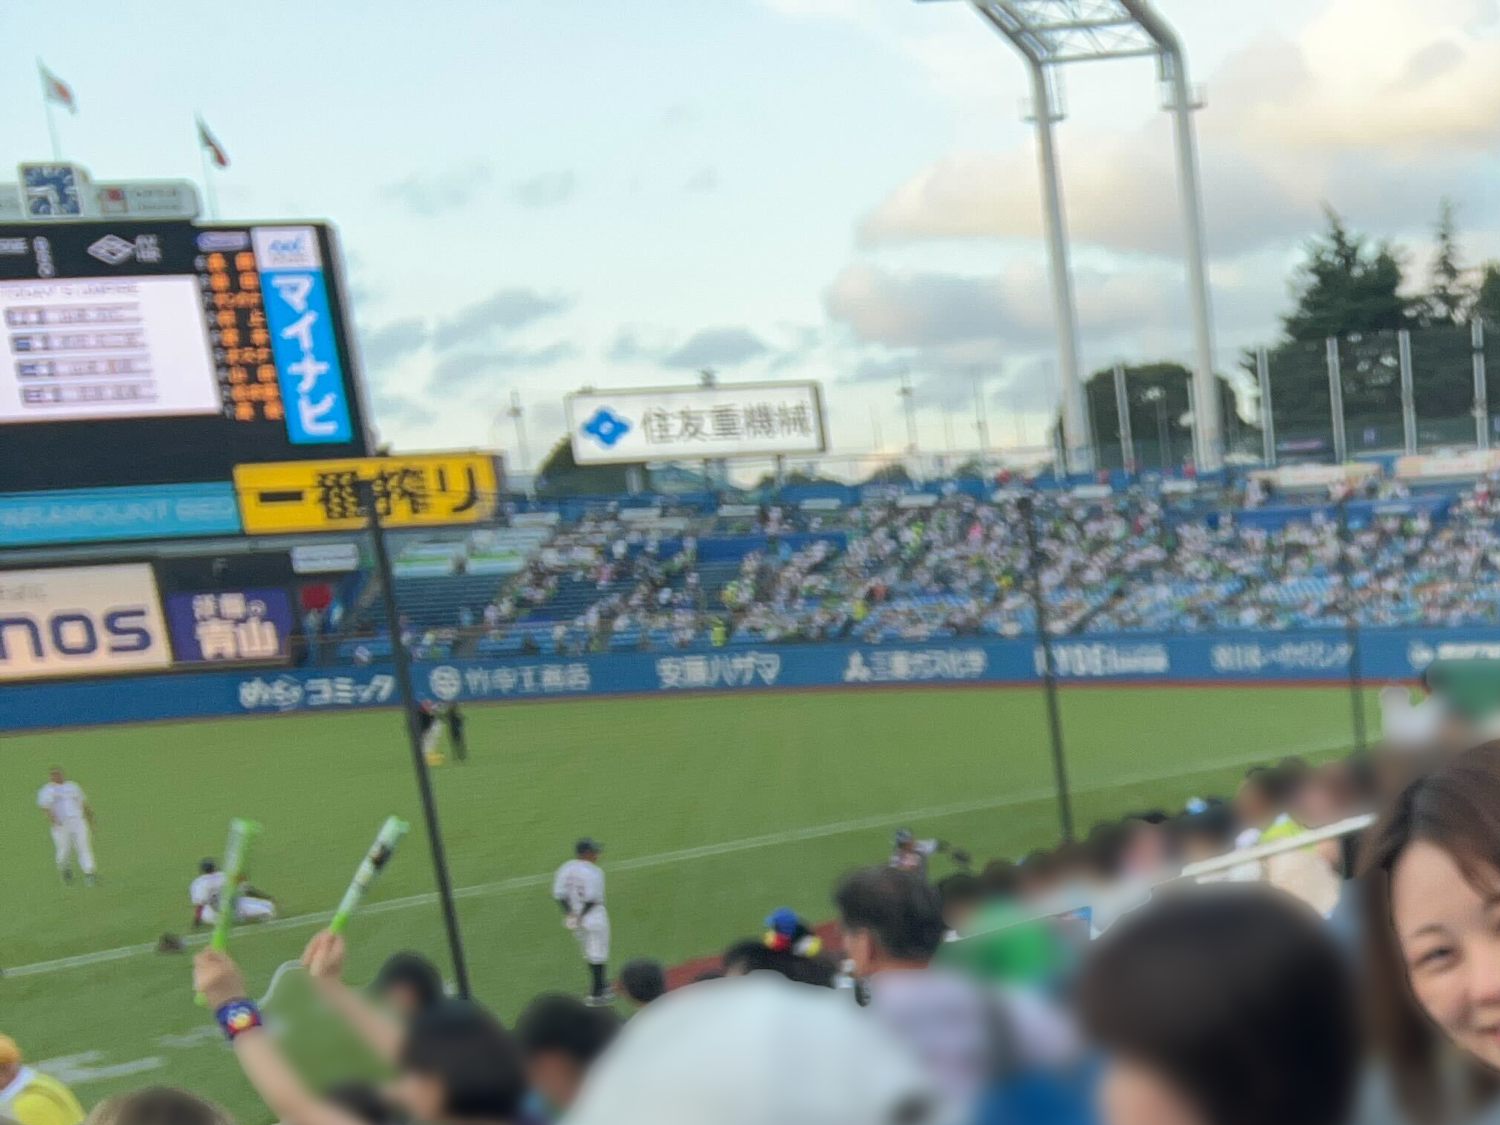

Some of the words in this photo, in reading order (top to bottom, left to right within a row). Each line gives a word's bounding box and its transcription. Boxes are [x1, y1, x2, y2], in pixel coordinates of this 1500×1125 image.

[641, 402, 812, 445] 住友重機械
